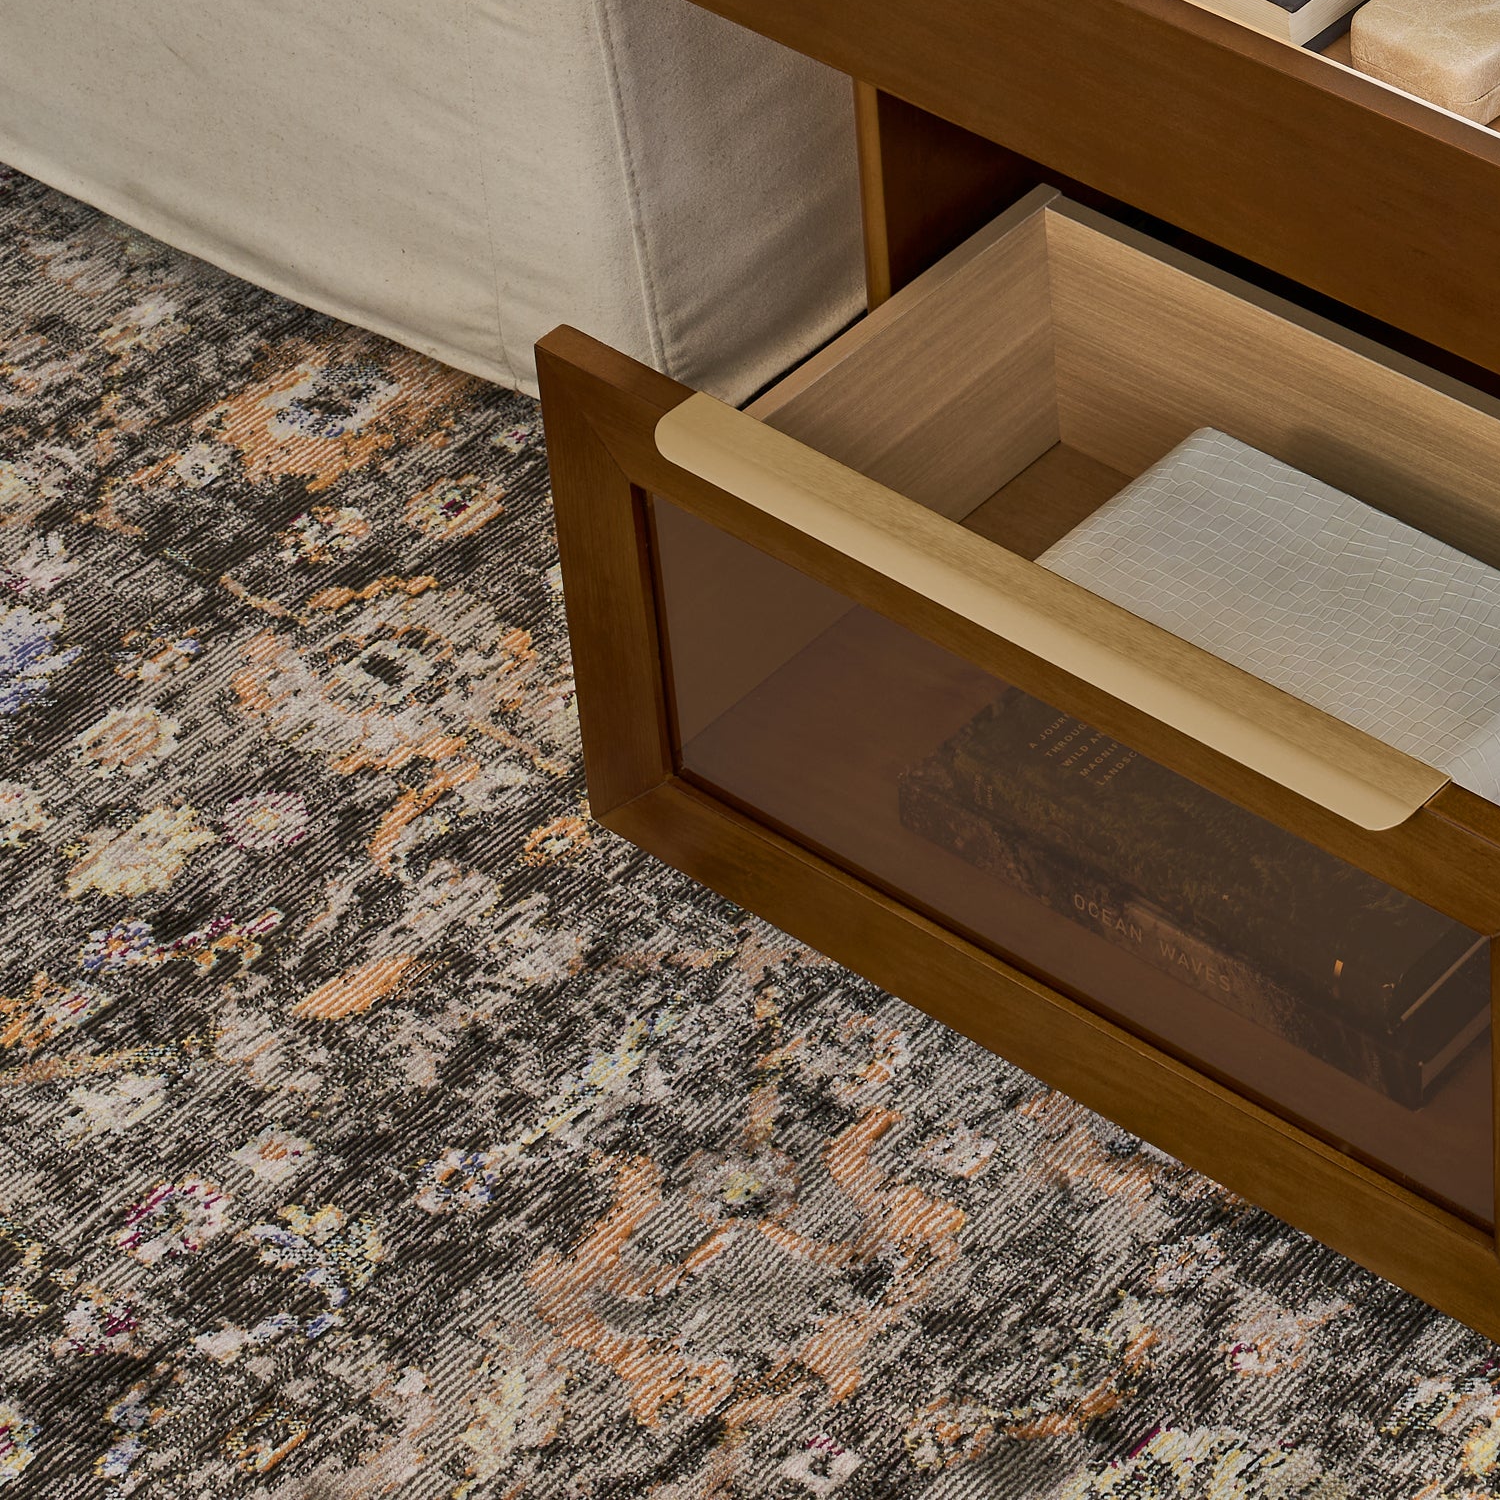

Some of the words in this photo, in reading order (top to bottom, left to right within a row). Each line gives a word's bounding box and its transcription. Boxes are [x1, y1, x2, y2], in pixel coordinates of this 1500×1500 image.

[1028, 741, 1038, 749] A
[1061, 745, 1089, 767] WILD
[1073, 893, 1143, 944] OCEAN
[1159, 940, 1231, 992] WAVES
